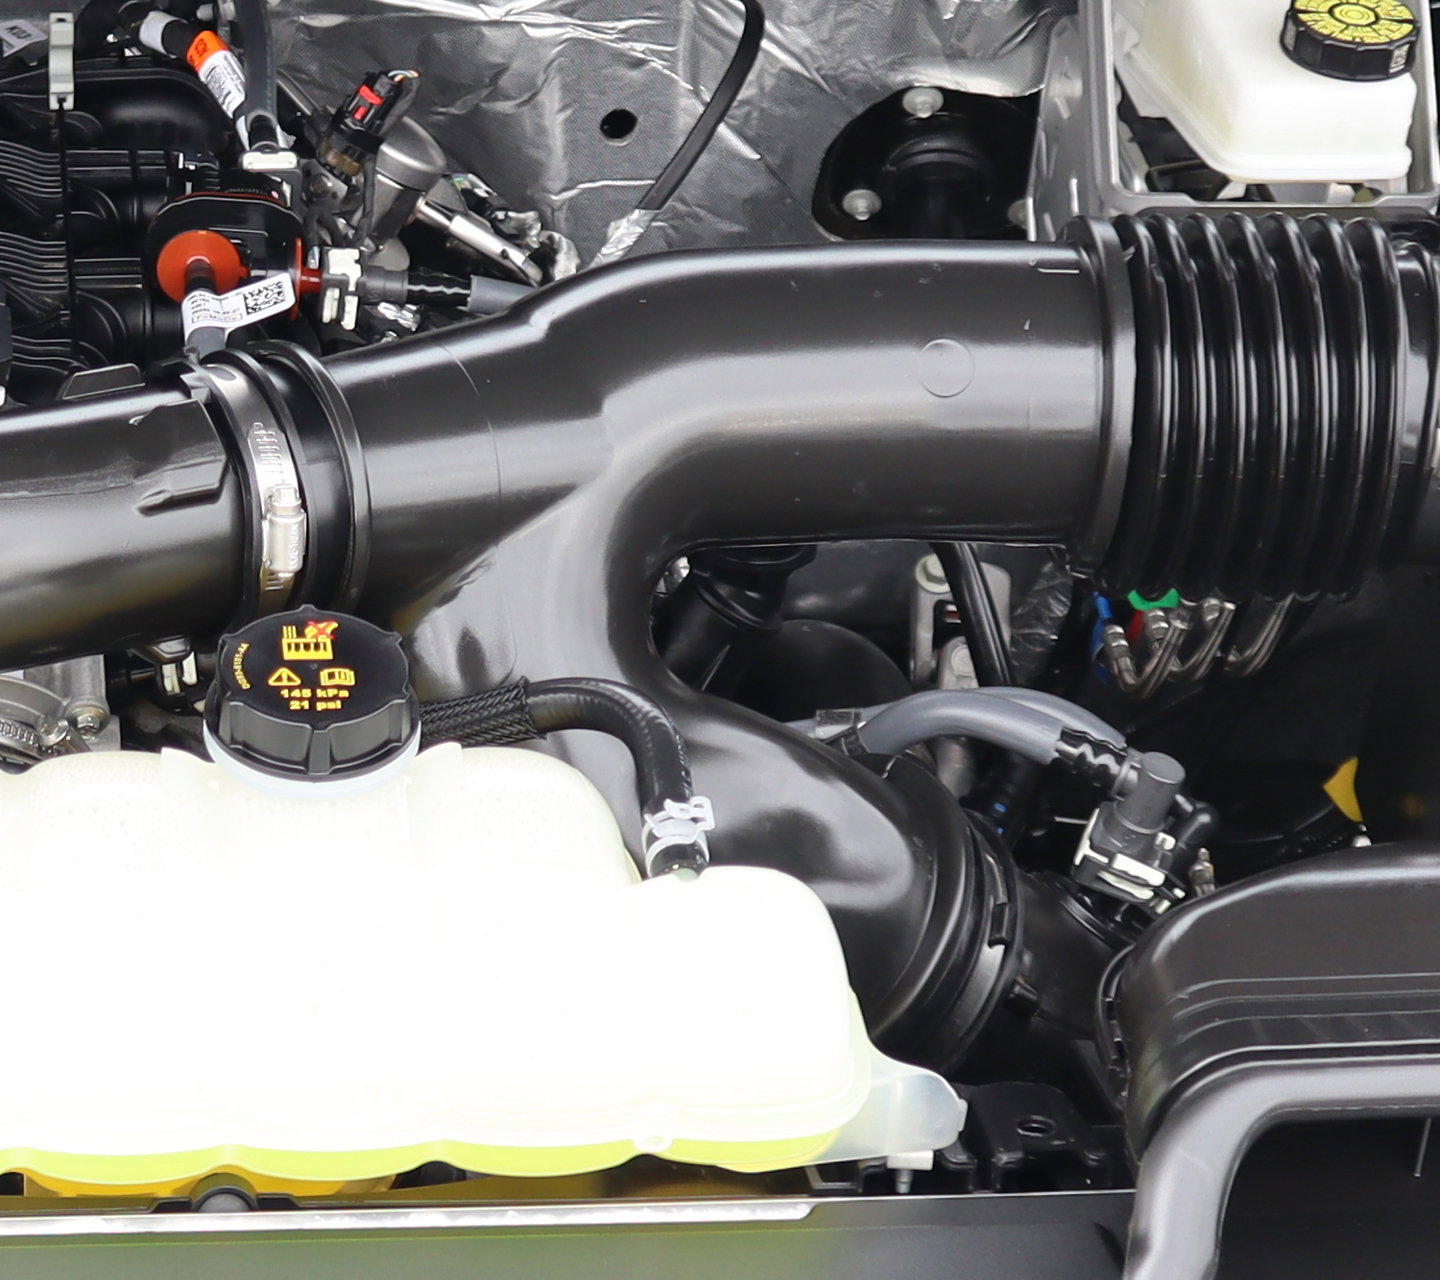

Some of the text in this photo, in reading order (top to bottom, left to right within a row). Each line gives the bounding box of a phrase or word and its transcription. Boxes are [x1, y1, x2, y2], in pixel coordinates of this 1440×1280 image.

[280, 688, 350, 699] 145 kPa
[289, 699, 342, 711] 21 psi
